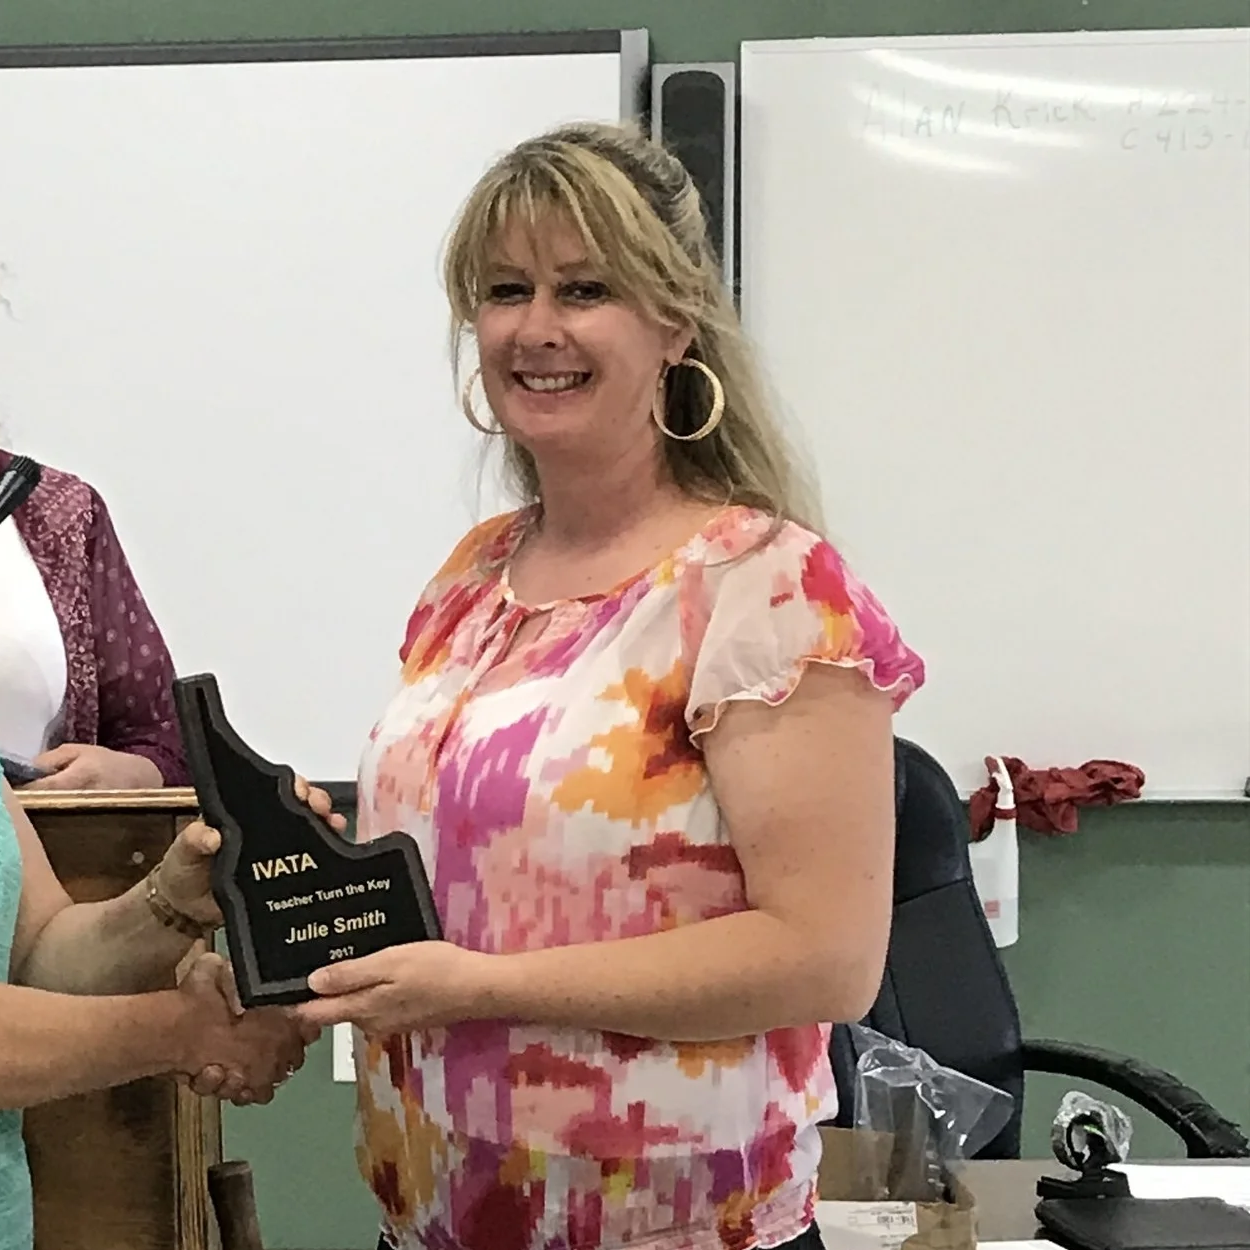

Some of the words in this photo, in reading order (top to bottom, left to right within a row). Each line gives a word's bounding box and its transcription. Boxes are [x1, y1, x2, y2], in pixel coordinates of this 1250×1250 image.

[251, 852, 318, 881] IVATA
[266, 894, 314, 912] Teacher
[315, 889, 344, 902] Turn
[345, 882, 366, 896] the
[366, 877, 391, 891] Key
[285, 922, 329, 944] Julie
[333, 909, 387, 934] Smith
[329, 946, 355, 960] 2017
